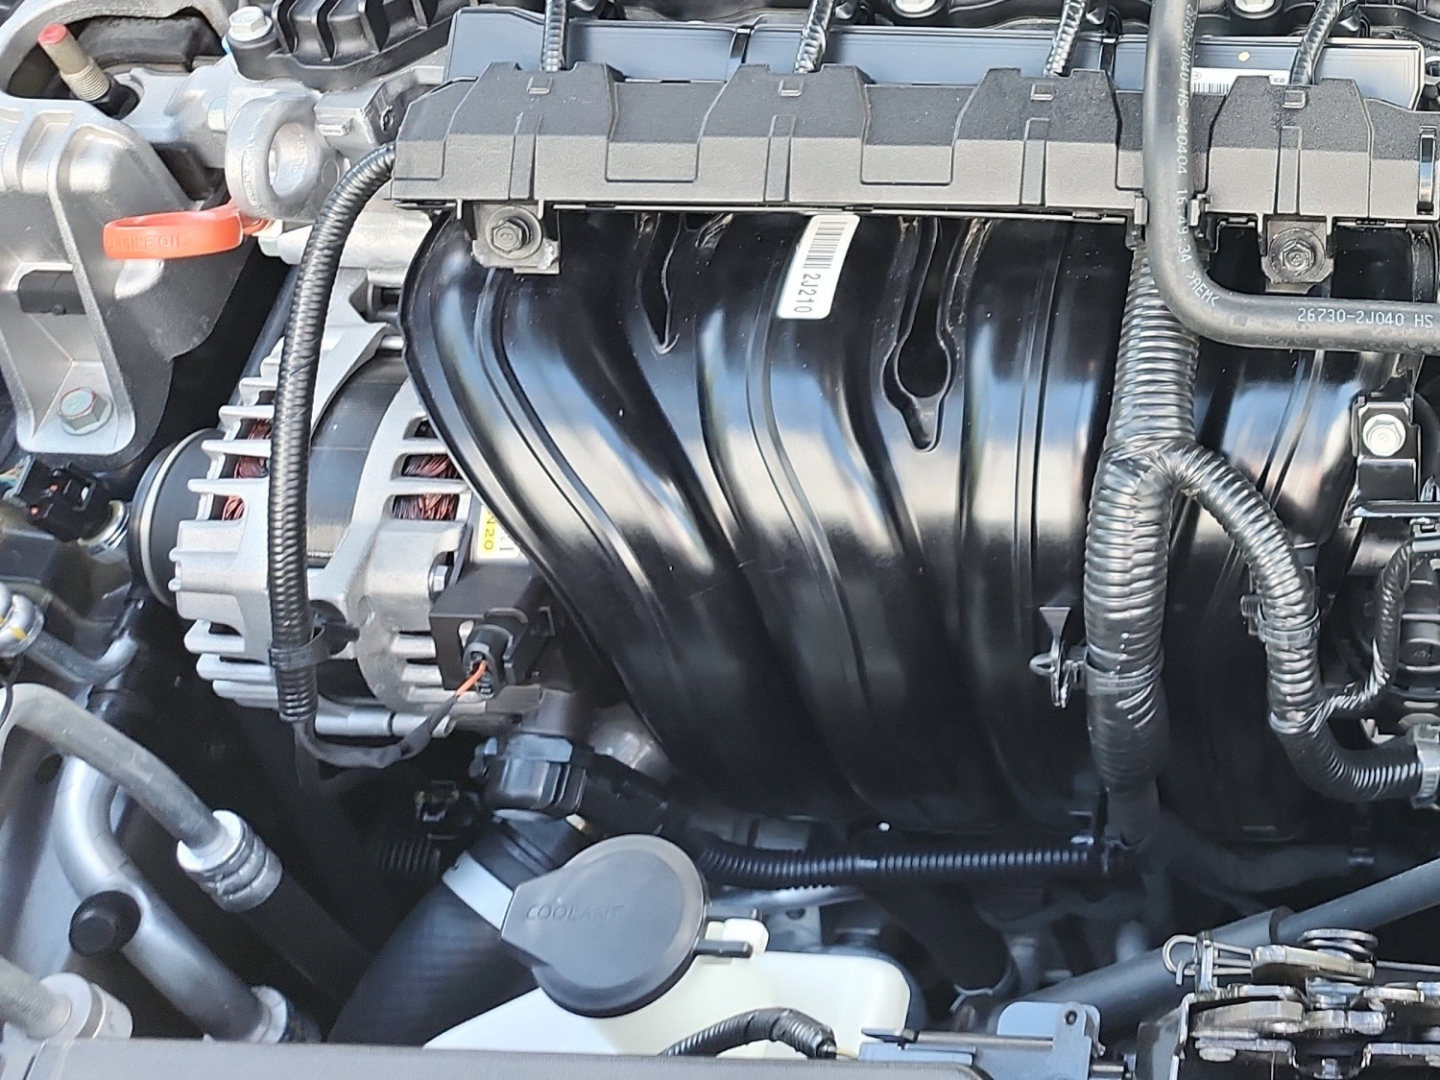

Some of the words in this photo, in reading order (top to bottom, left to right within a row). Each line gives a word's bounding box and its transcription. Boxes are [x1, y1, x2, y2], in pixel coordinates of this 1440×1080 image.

[1175, 115, 1189, 176] 240404
[793, 272, 822, 314] 2J210
[1297, 307, 1405, 327] 26730-2J040
[1413, 315, 1434, 329] HS
